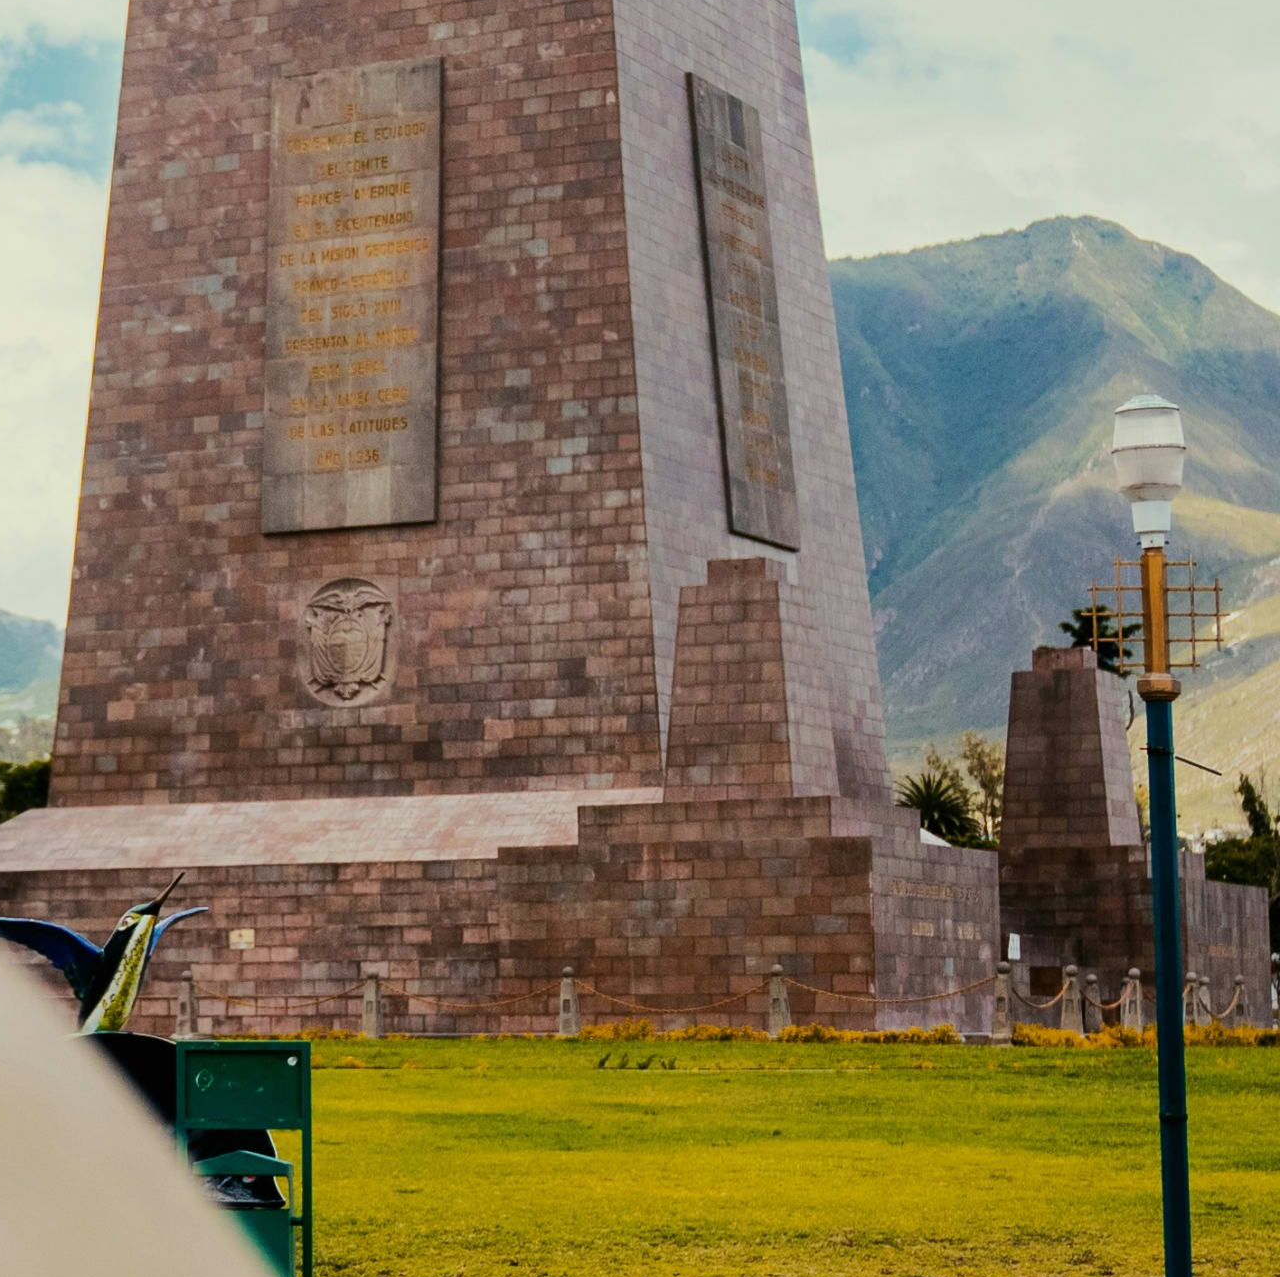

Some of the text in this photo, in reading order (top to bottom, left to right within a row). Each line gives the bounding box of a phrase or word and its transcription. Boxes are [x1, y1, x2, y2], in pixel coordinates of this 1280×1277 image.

[374, 121, 427, 142] ECUADOR
[344, 155, 389, 174] COMITE
[300, 251, 316, 266] LA
[321, 246, 359, 264] MISION
[331, 303, 366, 321] SIGLO
[311, 423, 335, 439] LAS
[341, 416, 408, 436] LATITUDES
